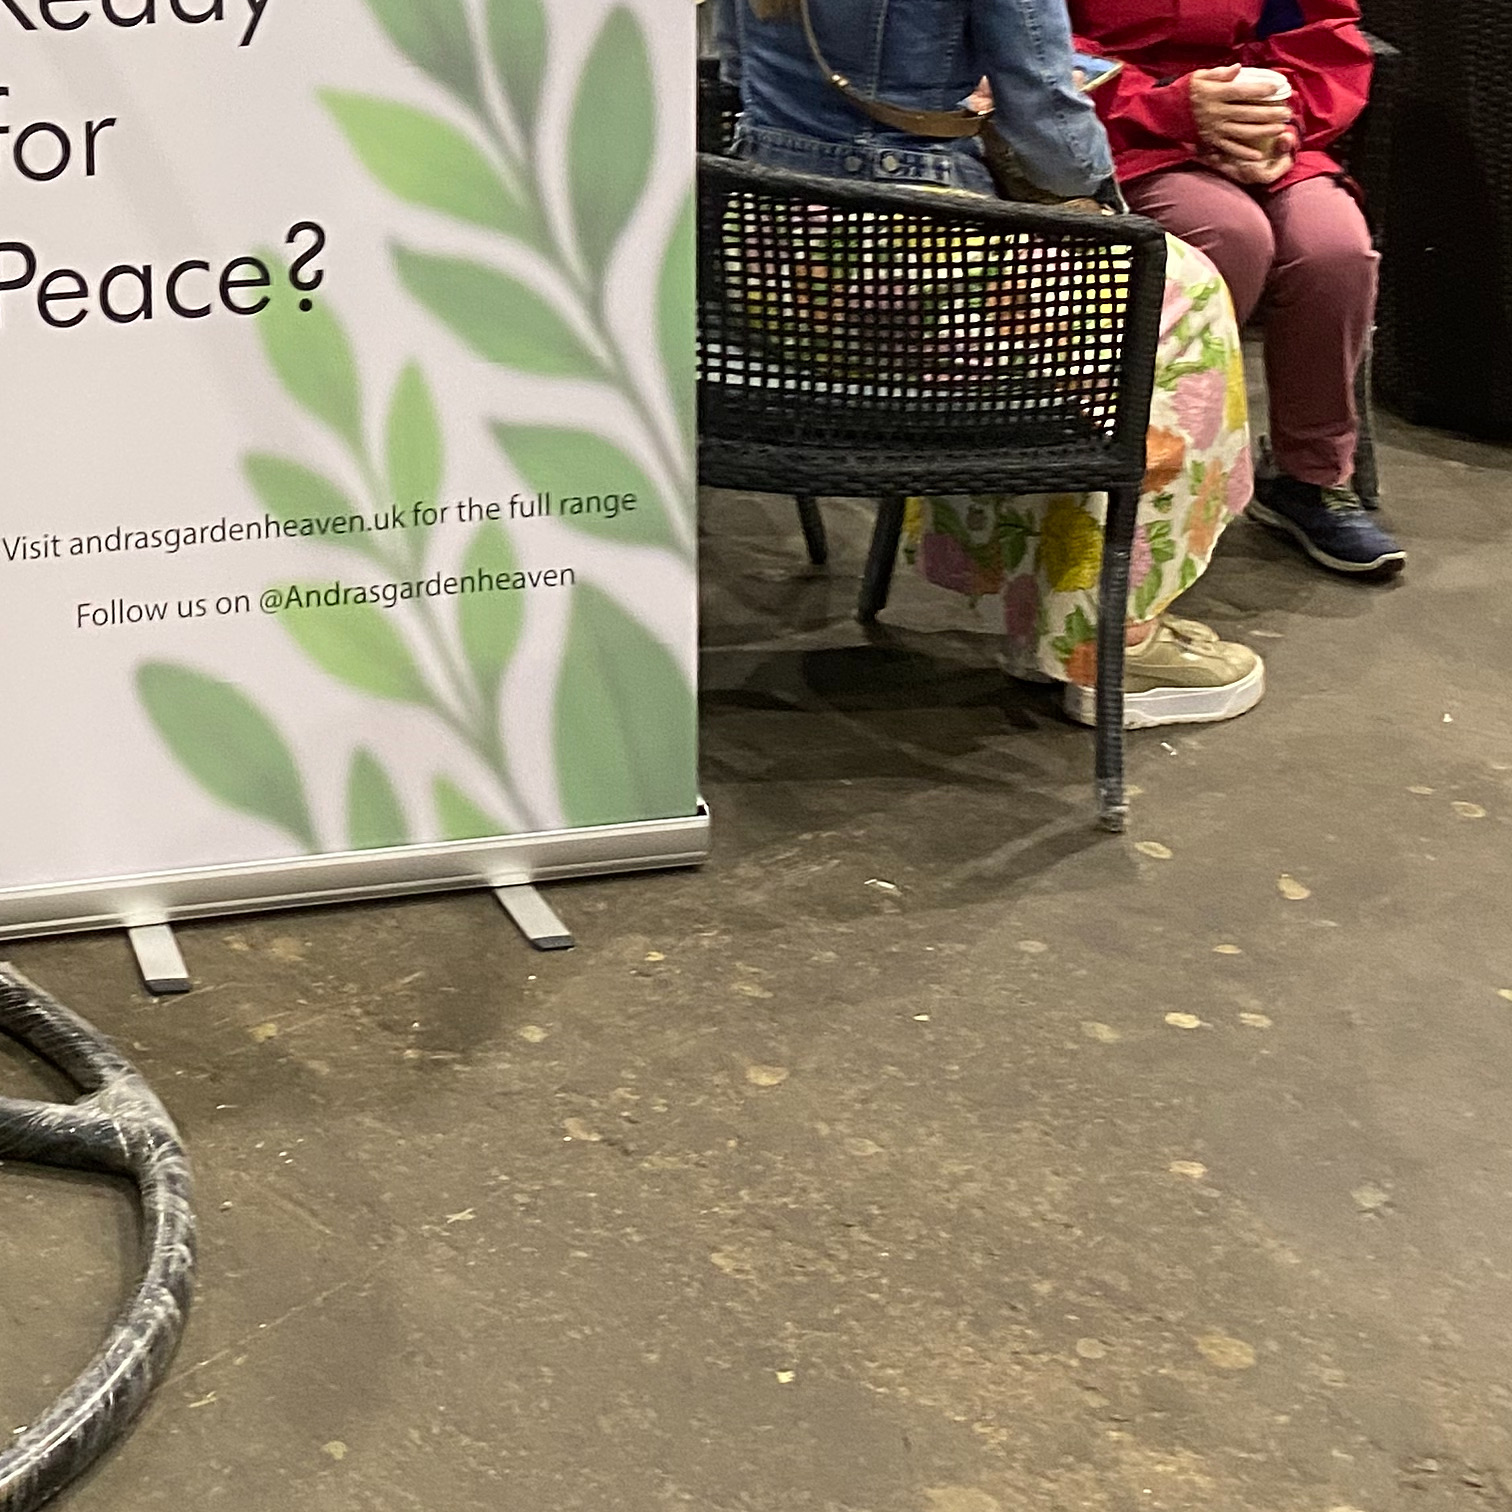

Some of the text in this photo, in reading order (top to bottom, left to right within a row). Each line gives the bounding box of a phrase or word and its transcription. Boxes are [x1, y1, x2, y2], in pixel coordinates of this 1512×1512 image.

[2, 491, 638, 561] Visit andrasgardenheaven.uk for the full range
[76, 566, 576, 628] Follow us on @Andrasgardenheaven
